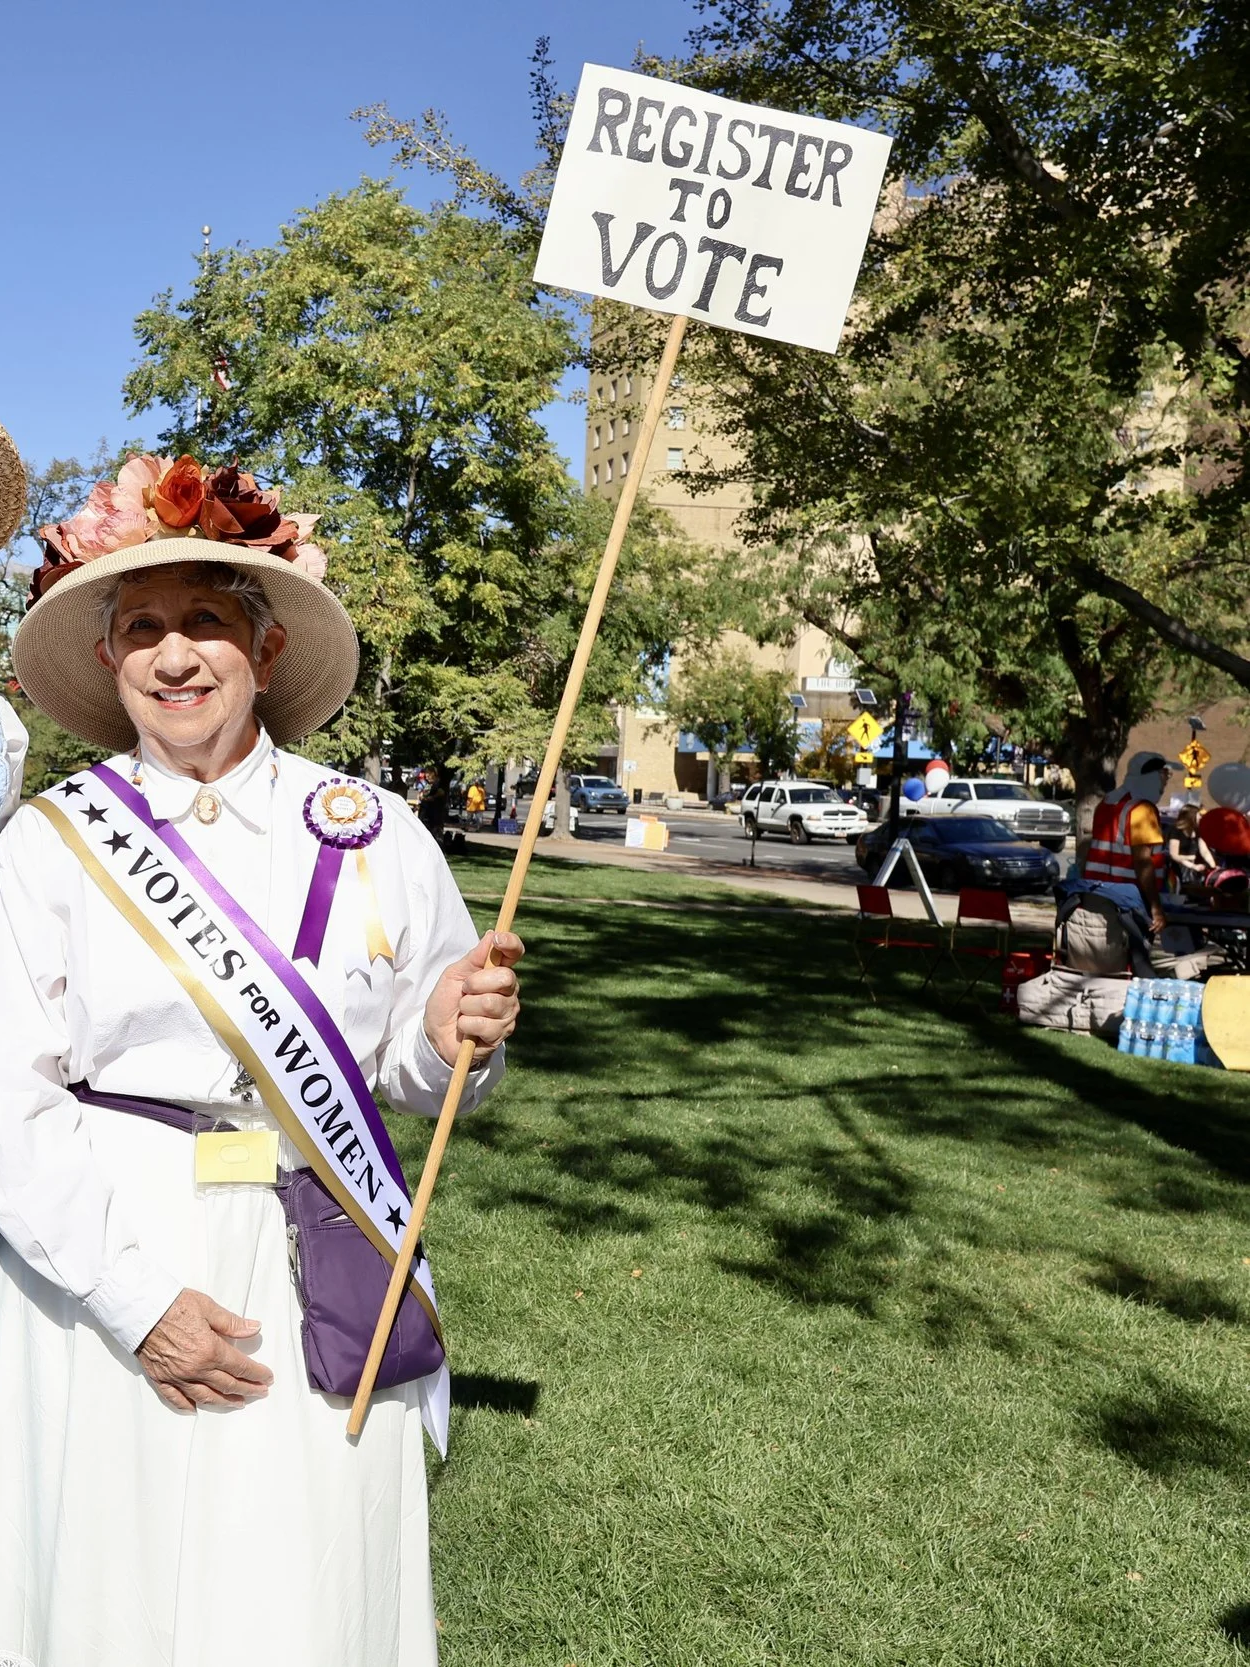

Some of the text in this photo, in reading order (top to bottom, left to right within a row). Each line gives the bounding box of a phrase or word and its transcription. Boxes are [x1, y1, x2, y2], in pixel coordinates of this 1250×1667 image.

[586, 87, 853, 207] REGISTER
[669, 177, 732, 230] TO
[591, 211, 784, 327] VOTE
[127, 846, 384, 1204] VOTES FOR WOMEN
